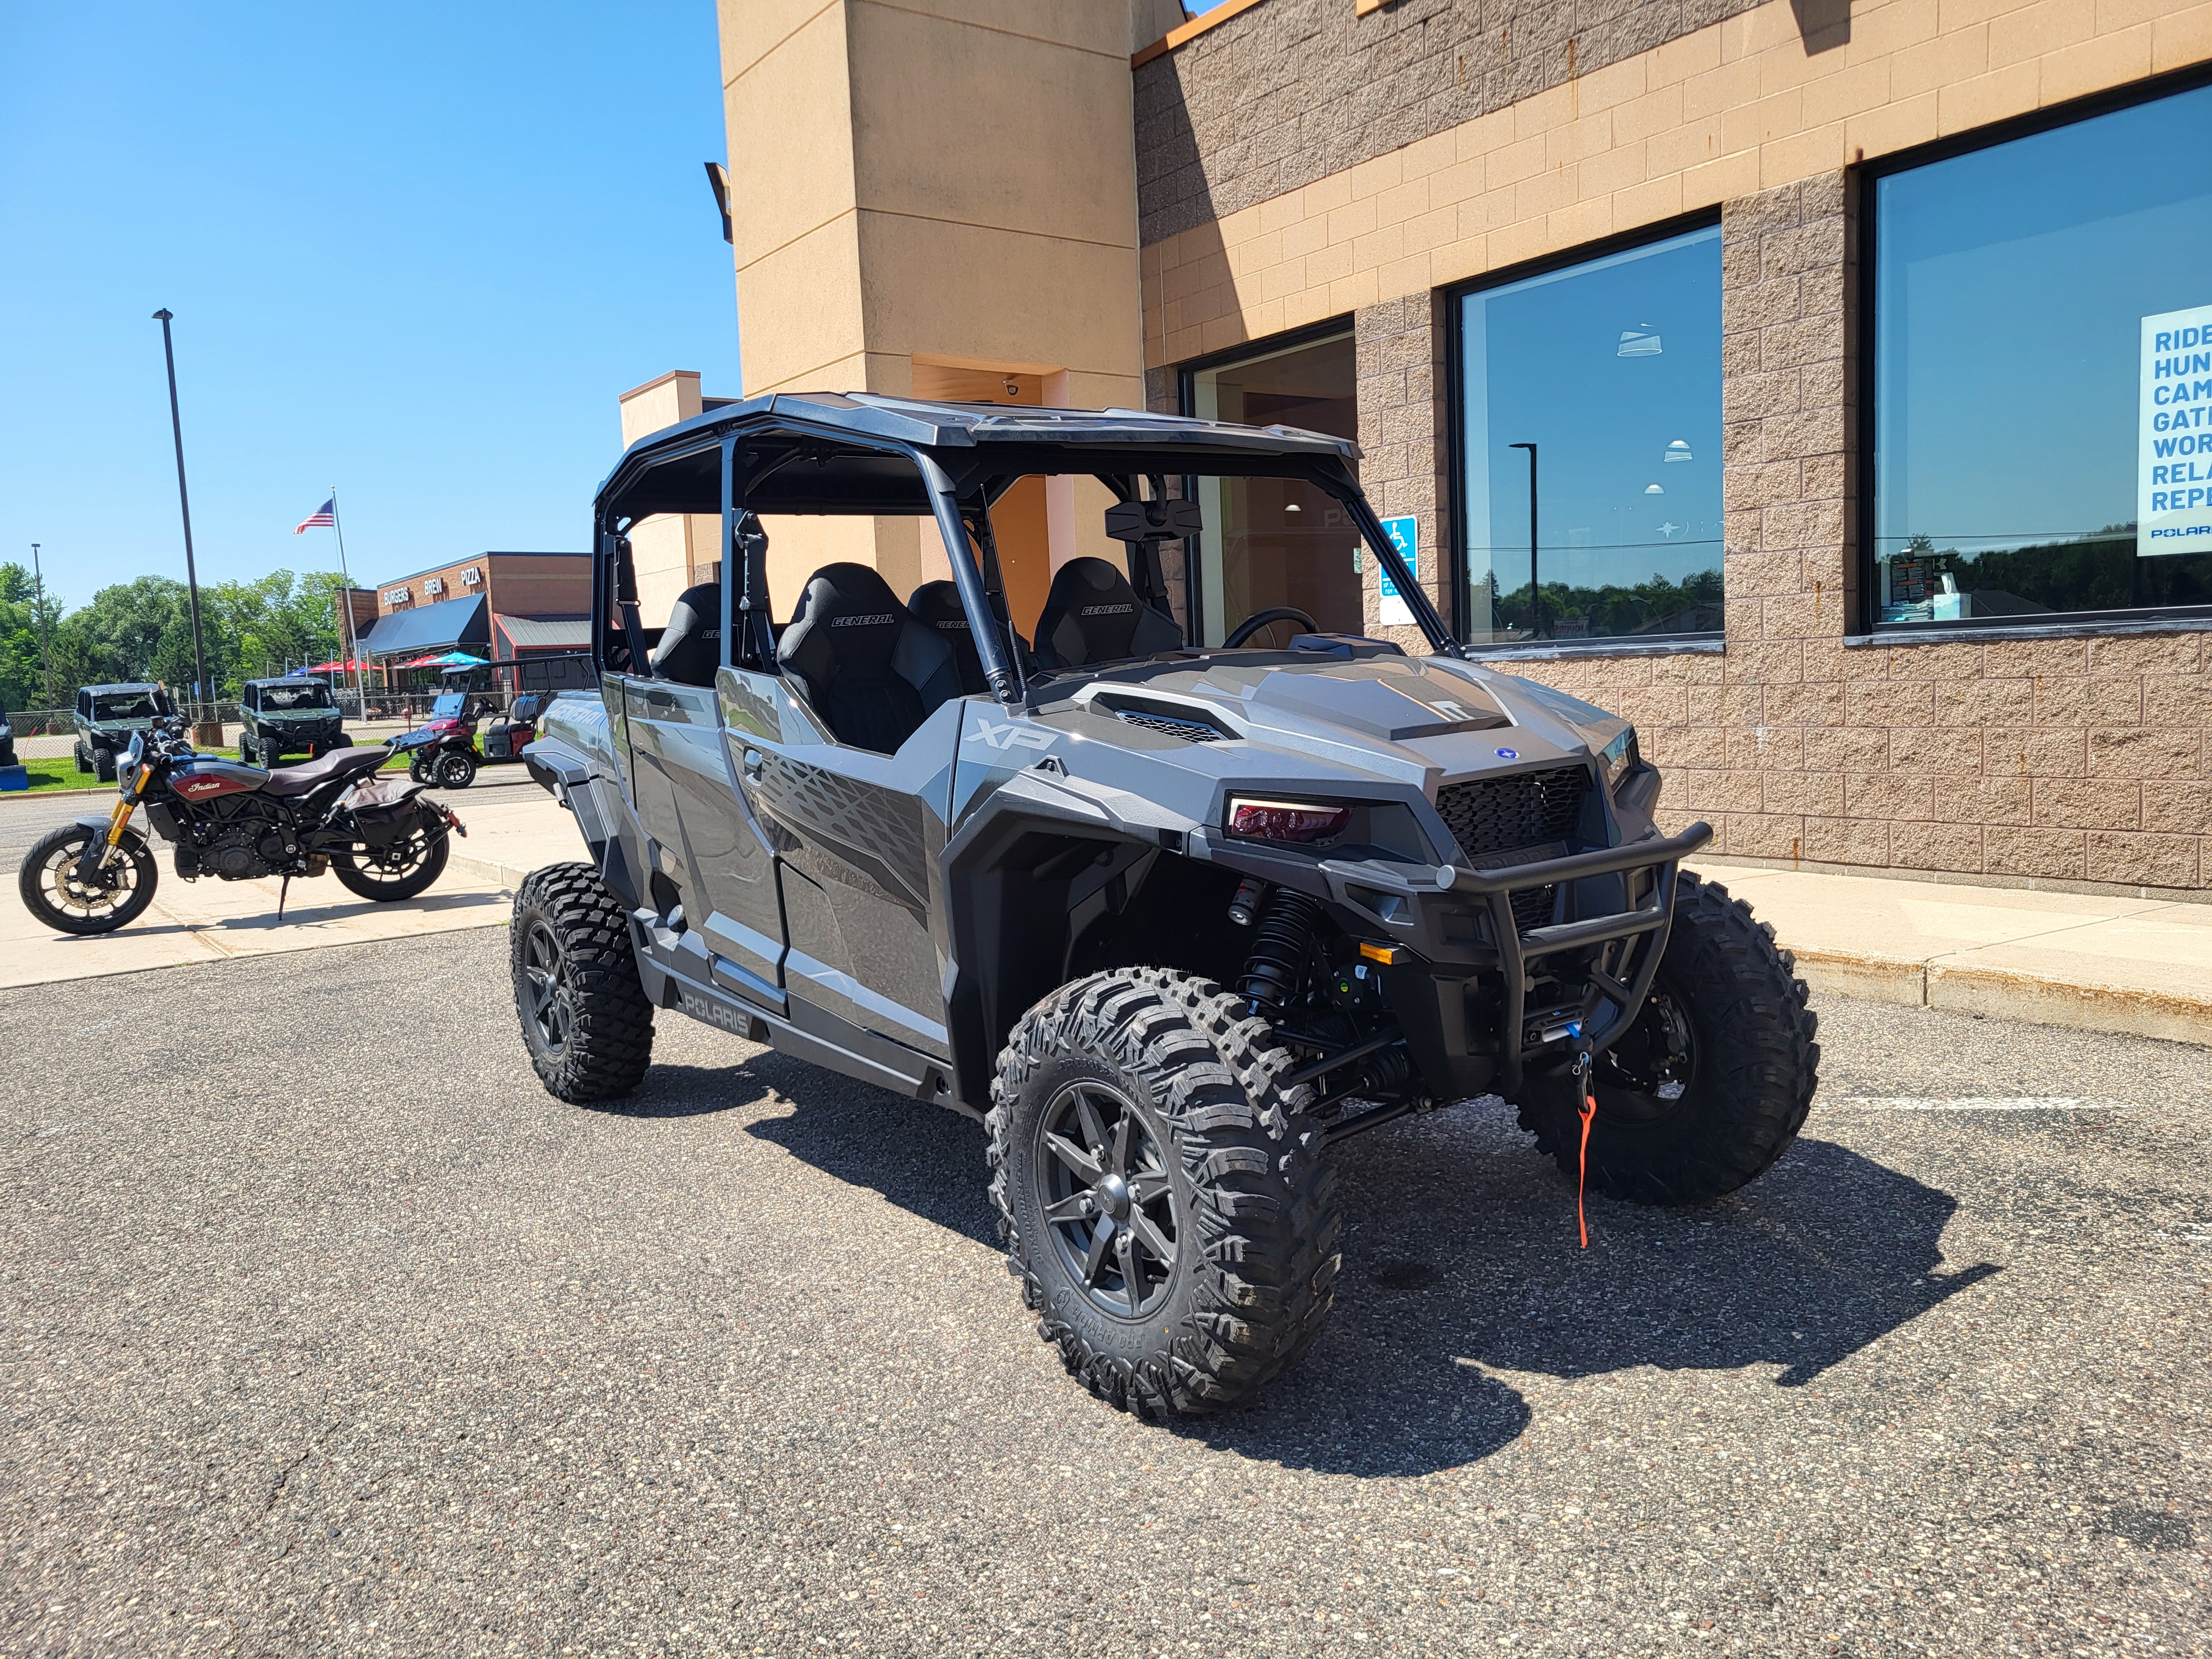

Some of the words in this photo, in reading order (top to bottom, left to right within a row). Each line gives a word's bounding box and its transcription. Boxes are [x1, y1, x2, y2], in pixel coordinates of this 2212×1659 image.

[2155, 324, 2212, 353] RIDE
[2154, 352, 2210, 380] HUN
[2154, 379, 2212, 406] CAM
[2153, 406, 2212, 432] GAT
[2153, 434, 2212, 458] WOR
[2151, 526, 2212, 539] POLAR
[384, 586, 409, 606] BURGERS
[425, 577, 442, 596] BREW
[461, 567, 481, 586] PIZZA
[831, 614, 894, 627] GENERAL
[1082, 604, 1133, 615] GENERAL
[963, 717, 1060, 750] XP
[188, 782, 220, 792] Indian
[684, 992, 749, 1034] POLARIS
